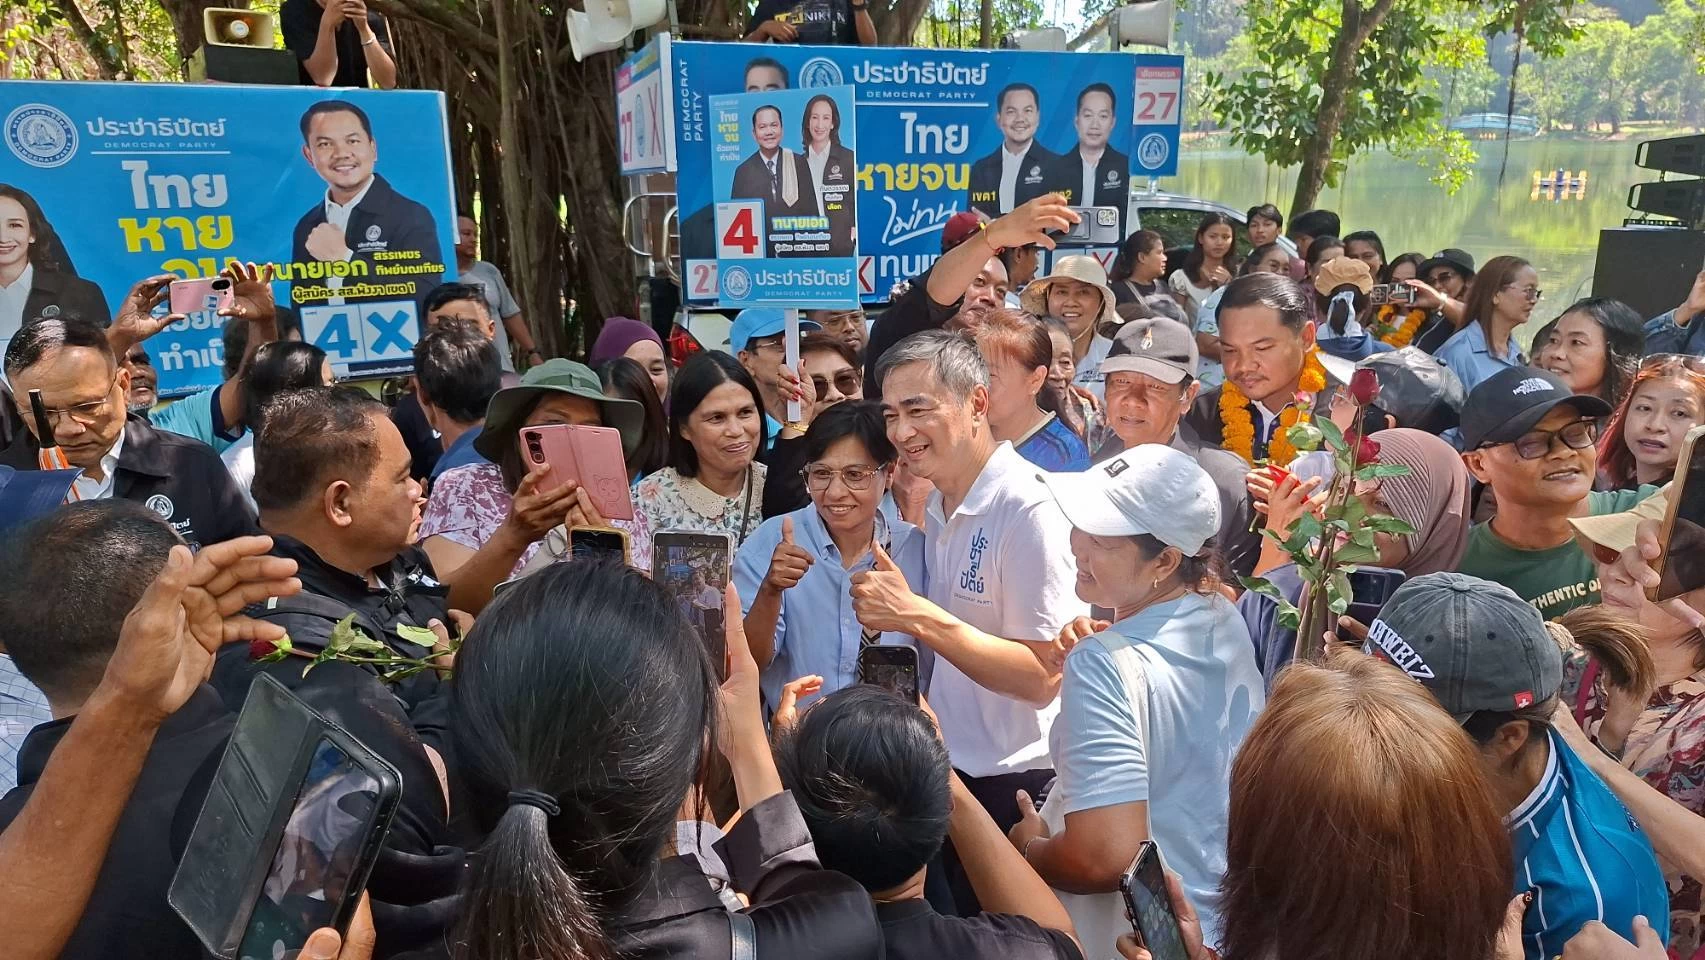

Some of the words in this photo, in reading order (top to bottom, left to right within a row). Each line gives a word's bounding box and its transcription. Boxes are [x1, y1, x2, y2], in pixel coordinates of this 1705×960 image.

[852, 60, 990, 85] ประชาธิปัตย์
[679, 58, 692, 142] DEMOCRAT
[692, 91, 704, 142] PARTY
[720, 110, 738, 122] ไทย
[1137, 92, 1177, 121] 27
[86, 117, 227, 137] ประชาธิปัตย์
[899, 112, 969, 155] ไทย
[121, 160, 228, 210] ไทย
[118, 215, 234, 253] หาย
[723, 208, 759, 254] 4
[773, 217, 829, 229] ทนายเอก
[387, 284, 406, 294] เขต
[755, 269, 852, 286] ประชาธิปัตย์
[314, 312, 357, 358] 4
